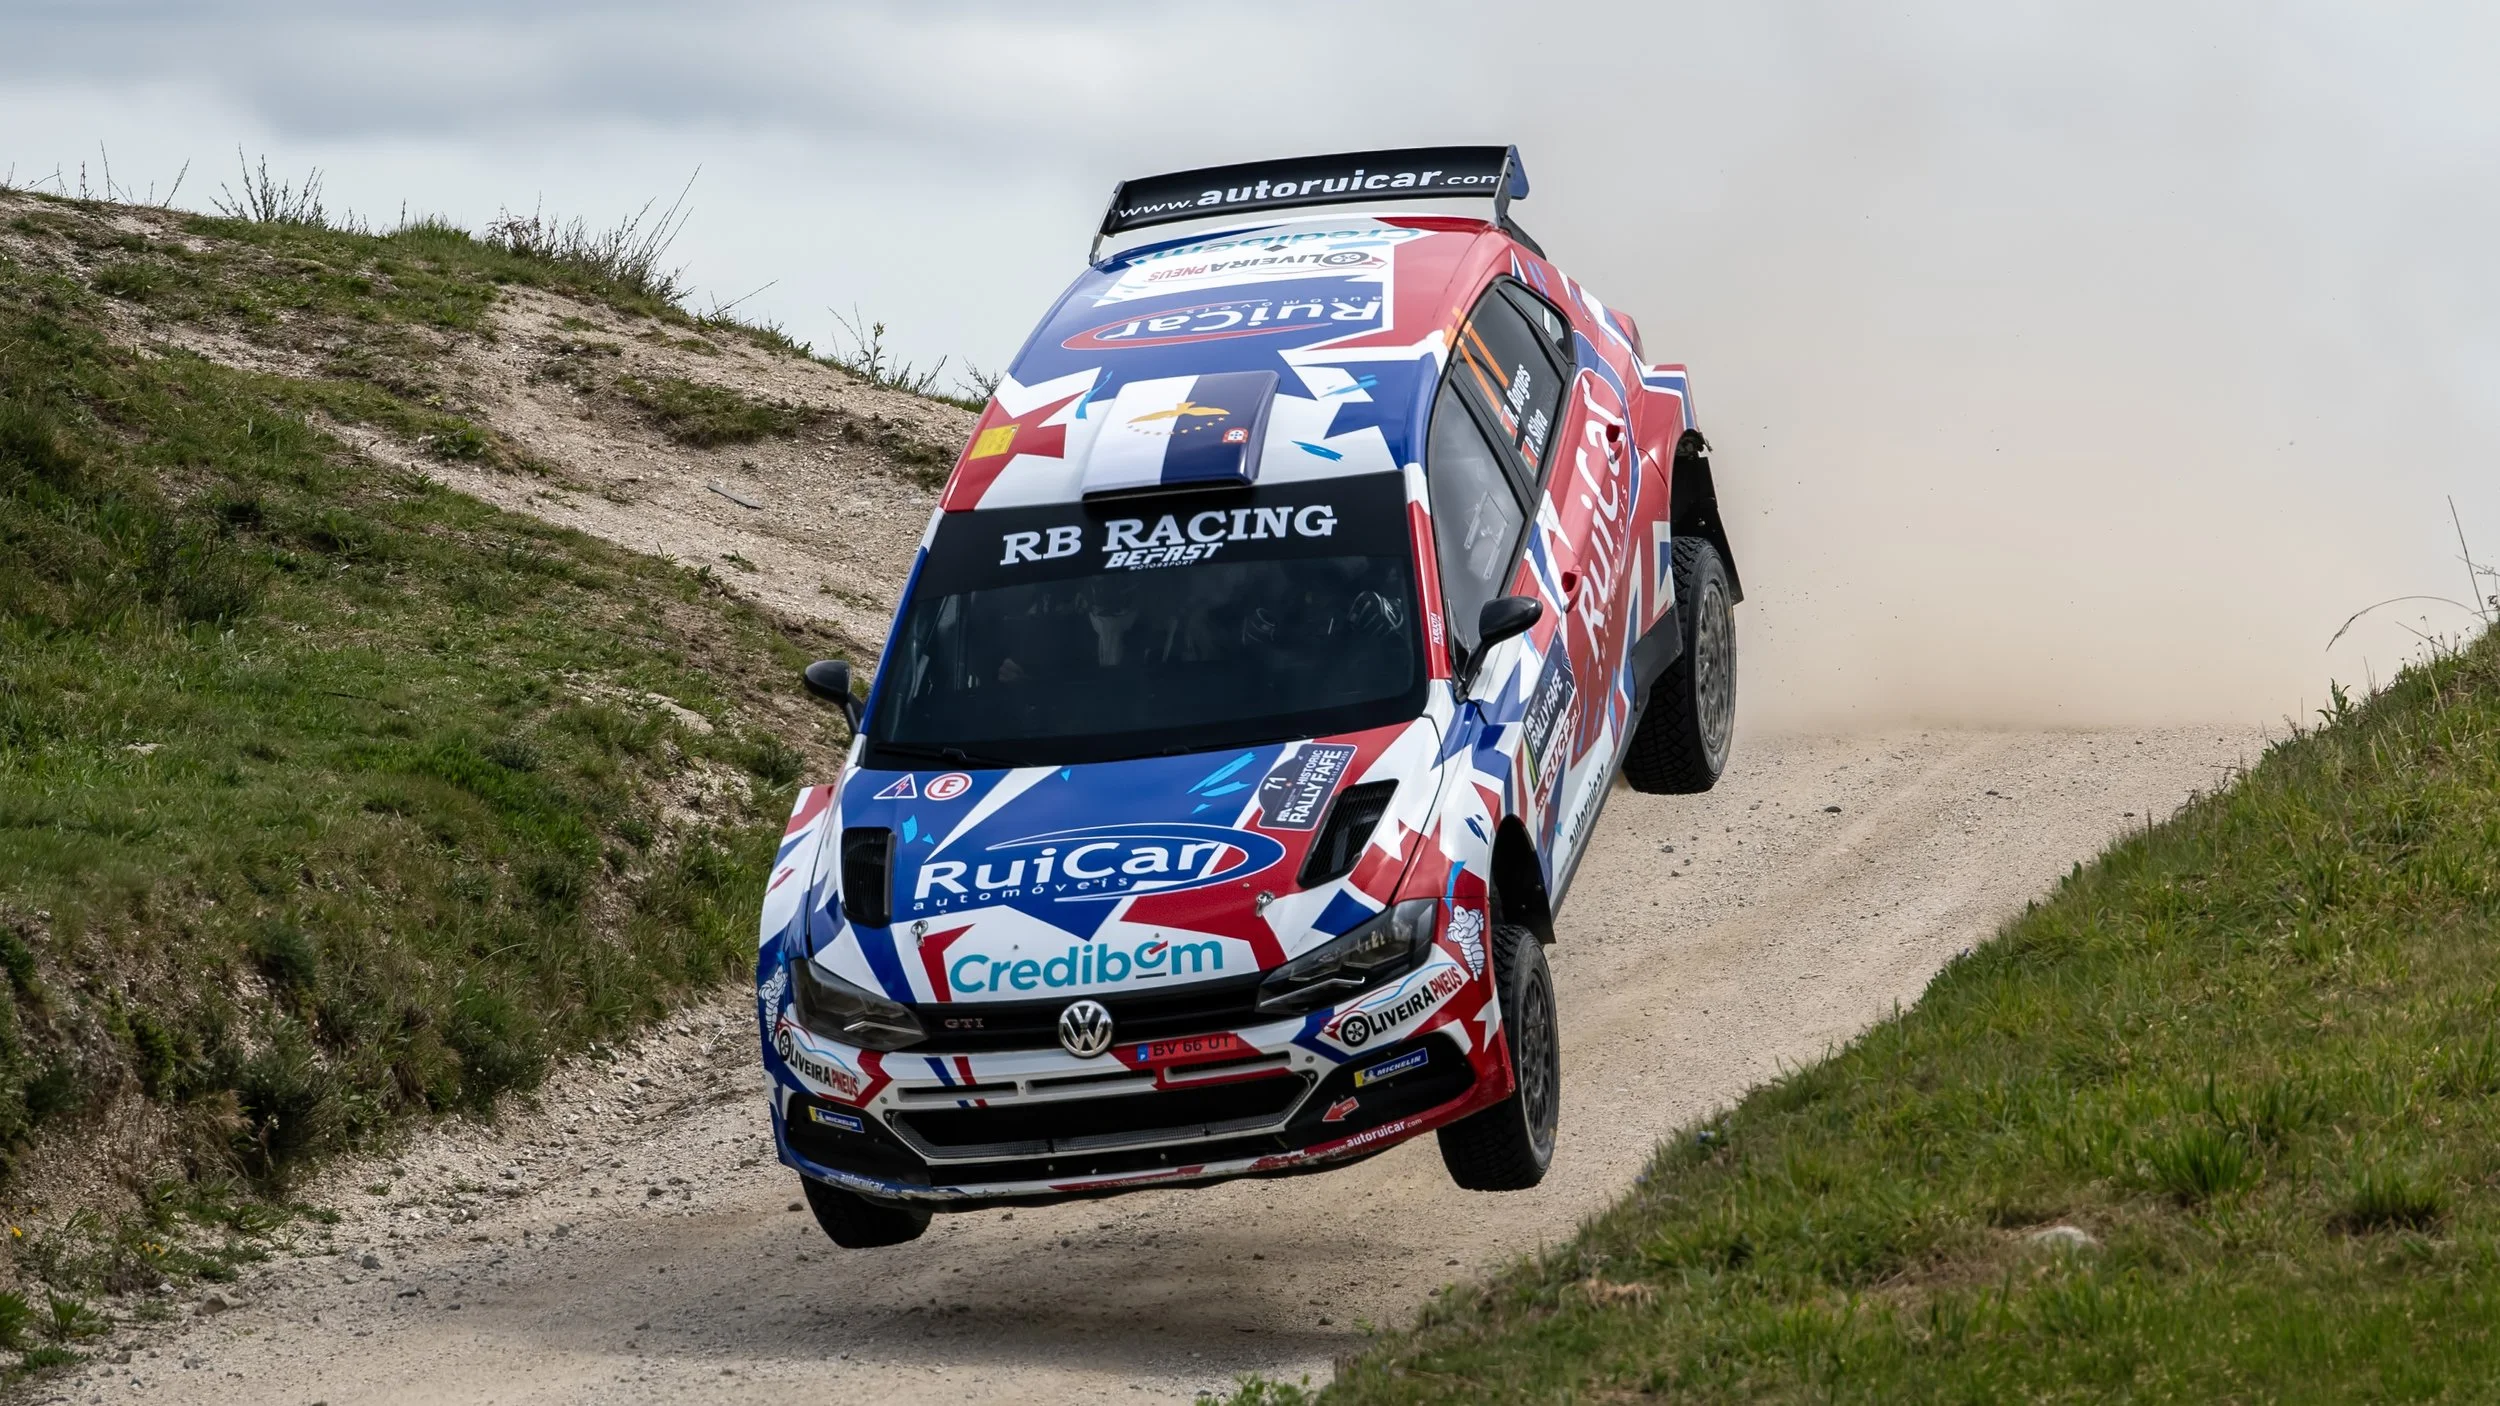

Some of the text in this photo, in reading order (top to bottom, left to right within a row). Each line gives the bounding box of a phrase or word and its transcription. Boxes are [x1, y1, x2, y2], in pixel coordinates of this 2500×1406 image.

[1103, 301, 1382, 340] RuiCar
[1506, 363, 1531, 414] Borges
[1528, 408, 1548, 446] Silva
[1000, 504, 1338, 566] RB RACING
[1575, 374, 1625, 664] RuiCar
[1104, 542, 1223, 569] BEFAST
[1129, 559, 1195, 571] MOTORSPORT
[1529, 703, 1551, 752] RALLY
[1547, 668, 1564, 711] FAFE
[940, 778, 959, 795] E
[1264, 777, 1287, 790] 71
[1288, 750, 1343, 823] RALLY FAFE
[1296, 750, 1323, 785] HISTORIC
[914, 840, 1220, 900] RuiCar
[950, 939, 1225, 994] Credibom
[944, 1018, 984, 1029] GTI
[1060, 1001, 1111, 1056] VW
[1153, 1043, 1177, 1057] BV
[1183, 1041, 1203, 1053] 66
[1208, 1037, 1230, 1049] UT
[1376, 1055, 1422, 1077] MICHELIN
